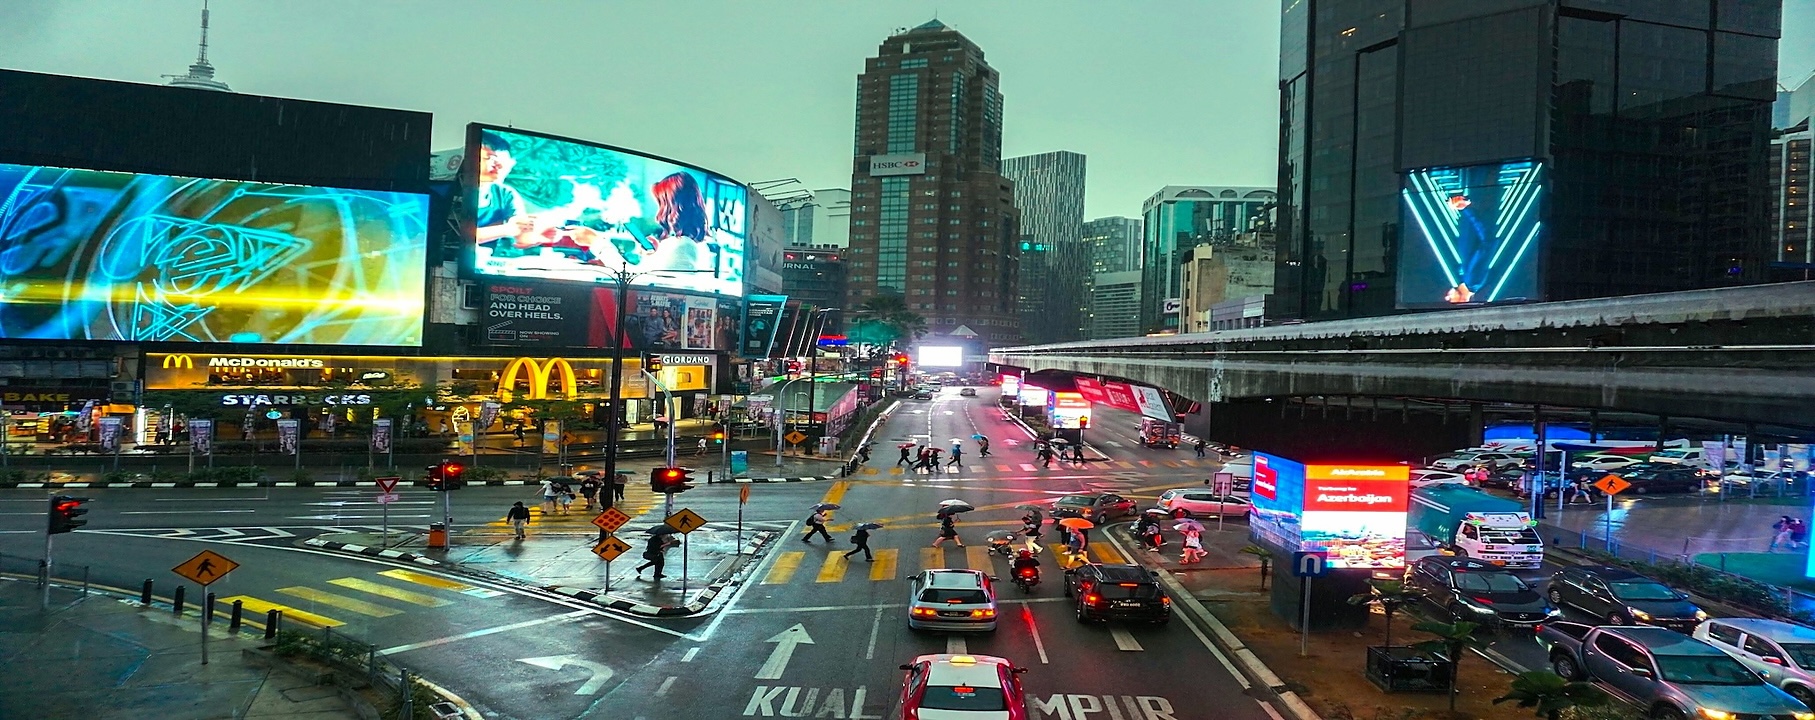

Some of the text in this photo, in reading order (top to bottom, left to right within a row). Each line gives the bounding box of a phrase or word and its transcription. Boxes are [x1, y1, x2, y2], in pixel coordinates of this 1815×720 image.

[873, 161, 903, 169] HSBC
[490, 285, 533, 295] SPOILT
[490, 293, 562, 305] FOR CHOICE
[490, 302, 551, 312] AND HEAD
[489, 310, 564, 320] OVER HEELS.
[208, 357, 324, 368] McDonald's
[662, 355, 710, 364] GIORDANO
[3, 392, 70, 402] BAKE
[1316, 493, 1393, 505] Azerbaijan
[742, 685, 1178, 720] KUAL MPUR
